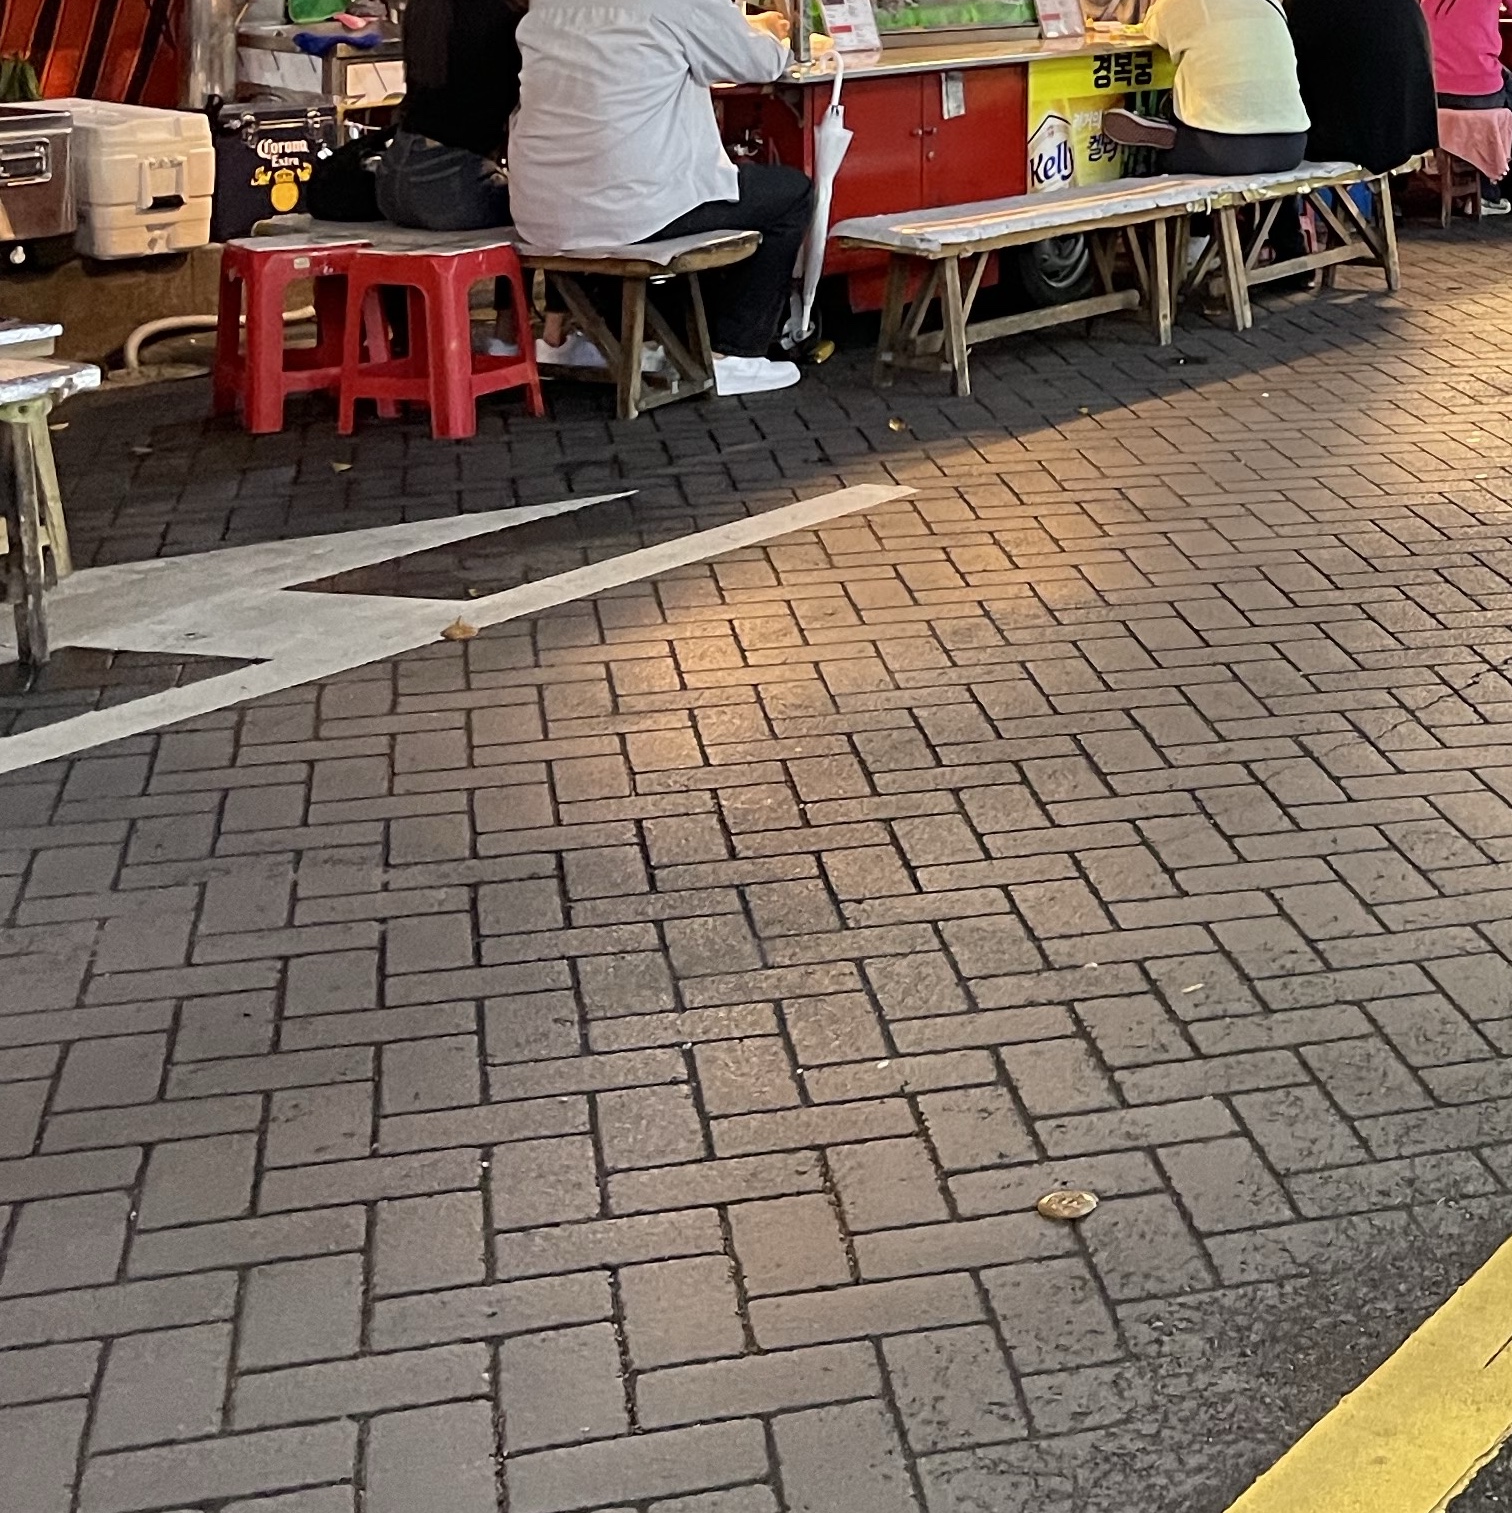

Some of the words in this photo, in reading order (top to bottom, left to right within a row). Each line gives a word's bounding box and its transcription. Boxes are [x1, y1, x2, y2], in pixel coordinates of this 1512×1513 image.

[1093, 51, 1154, 89] 경복궁
[256, 138, 310, 160] Corona
[271, 154, 300, 168] Extra
[1029, 140, 1075, 187] Kelly
